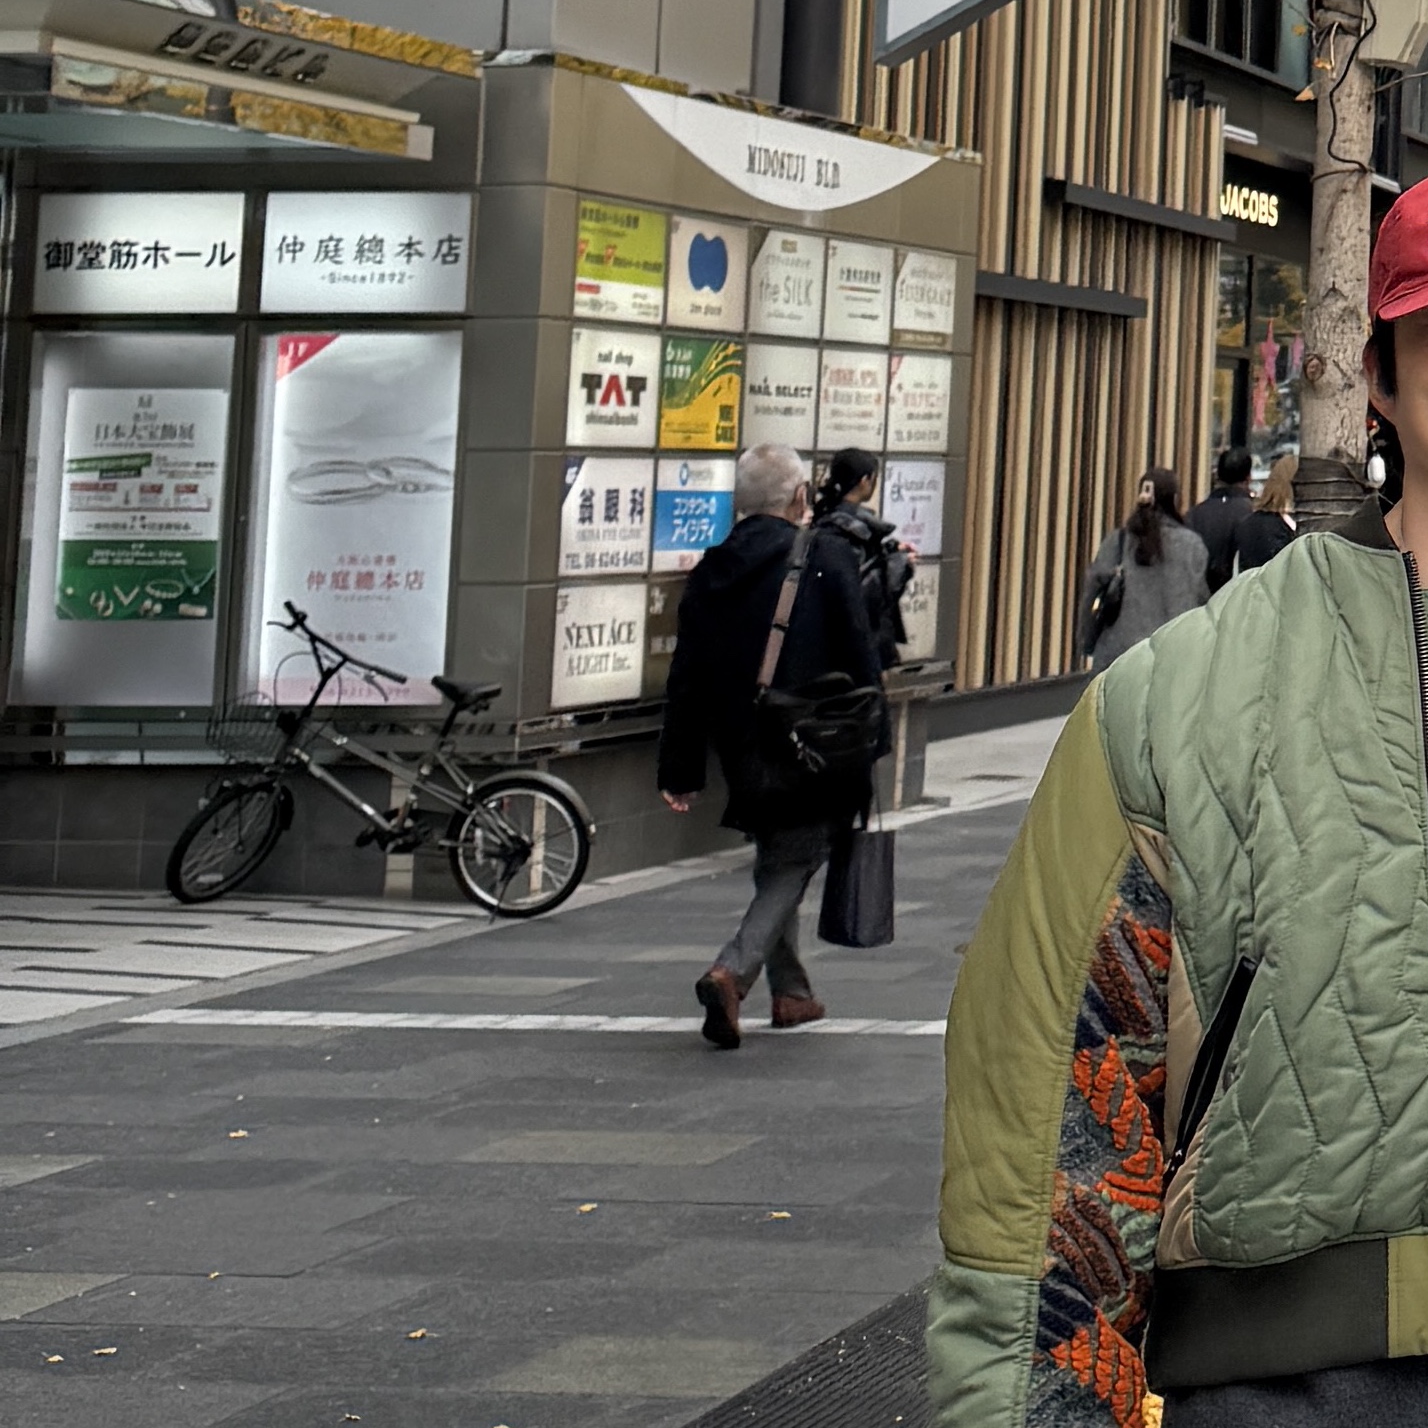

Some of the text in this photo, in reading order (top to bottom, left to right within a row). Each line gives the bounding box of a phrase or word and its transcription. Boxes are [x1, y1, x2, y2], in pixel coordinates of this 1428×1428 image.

[747, 144, 806, 183] MIDOSUJI
[1220, 183, 1279, 227] JACOBS
[44, 239, 236, 270] 御堂筋ホール
[581, 373, 647, 407] TAT
[775, 384, 813, 398] SELECT
[563, 622, 606, 650] NEXT
